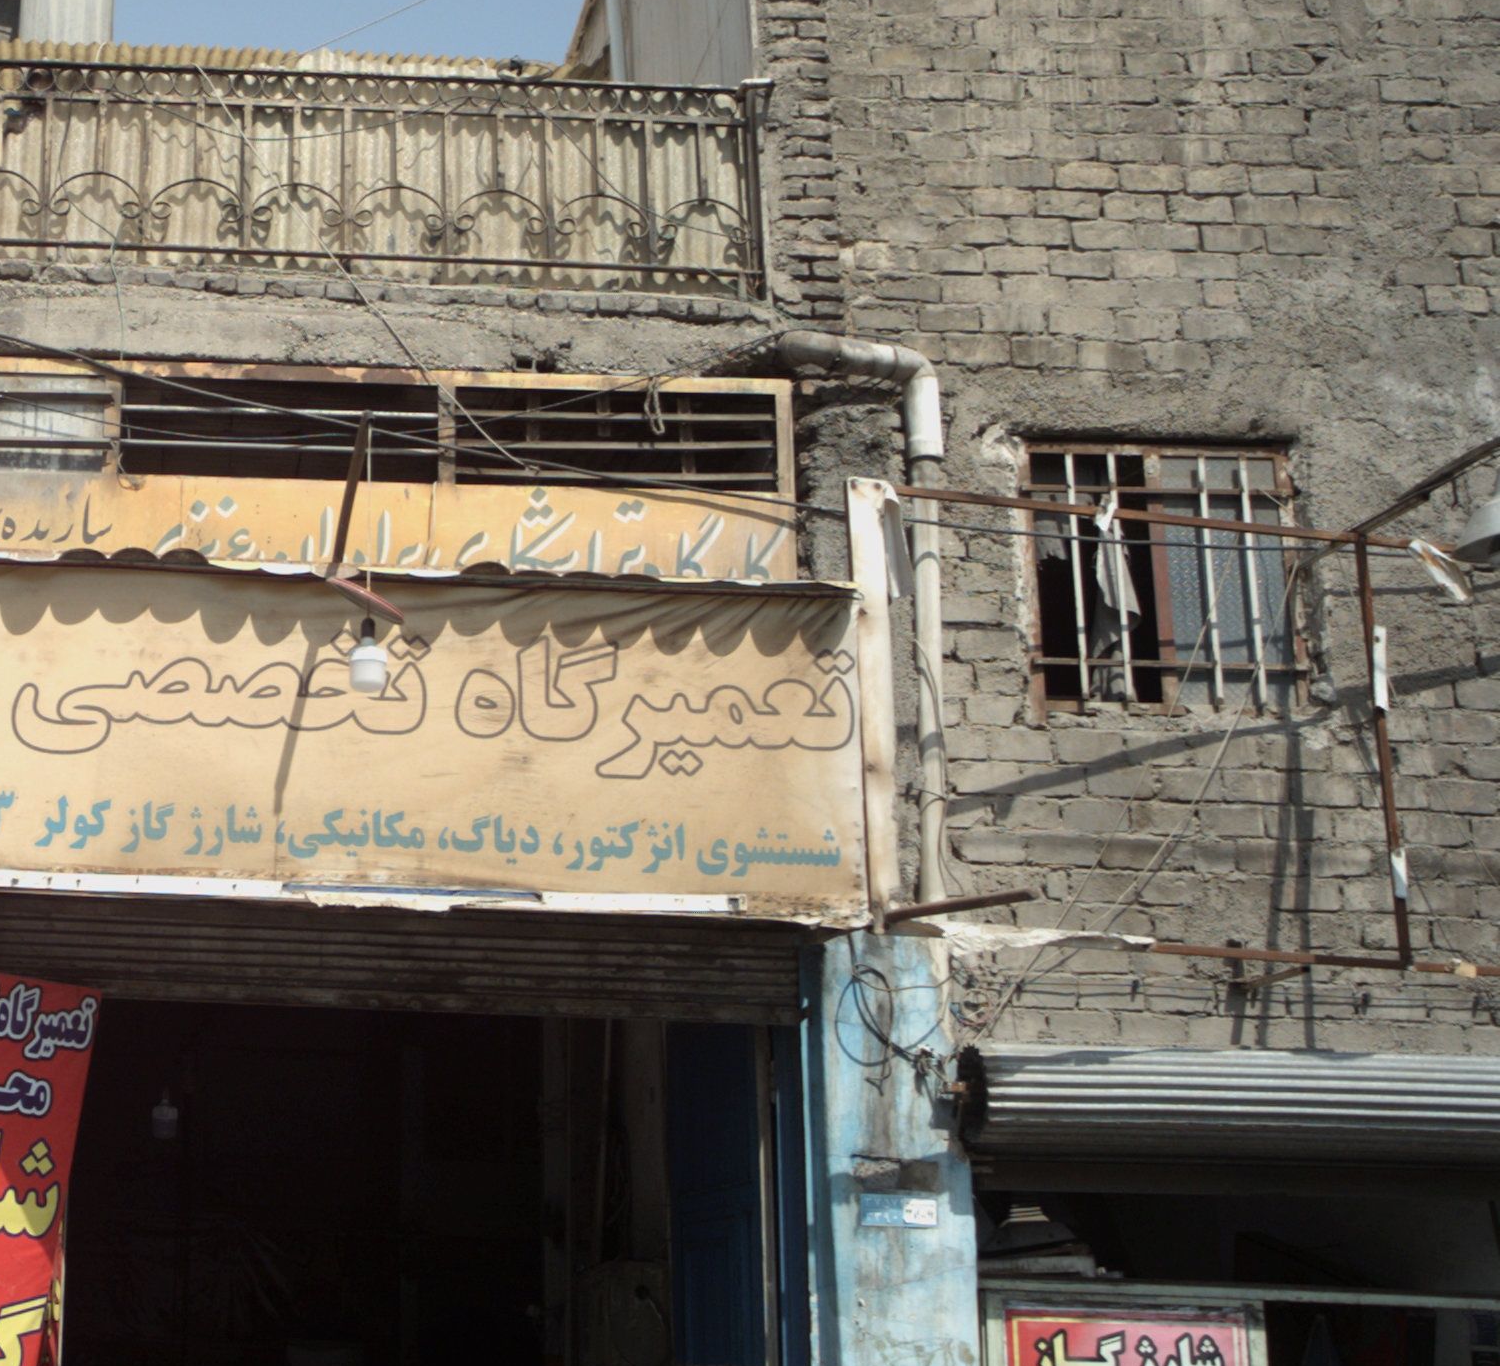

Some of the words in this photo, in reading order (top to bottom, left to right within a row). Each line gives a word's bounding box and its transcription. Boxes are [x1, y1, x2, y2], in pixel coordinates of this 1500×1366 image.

[34, 795, 112, 849] کولر
[120, 801, 174, 853] گاز
[183, 805, 264, 857] شارژ
[696, 829, 843, 877] شستشوی
